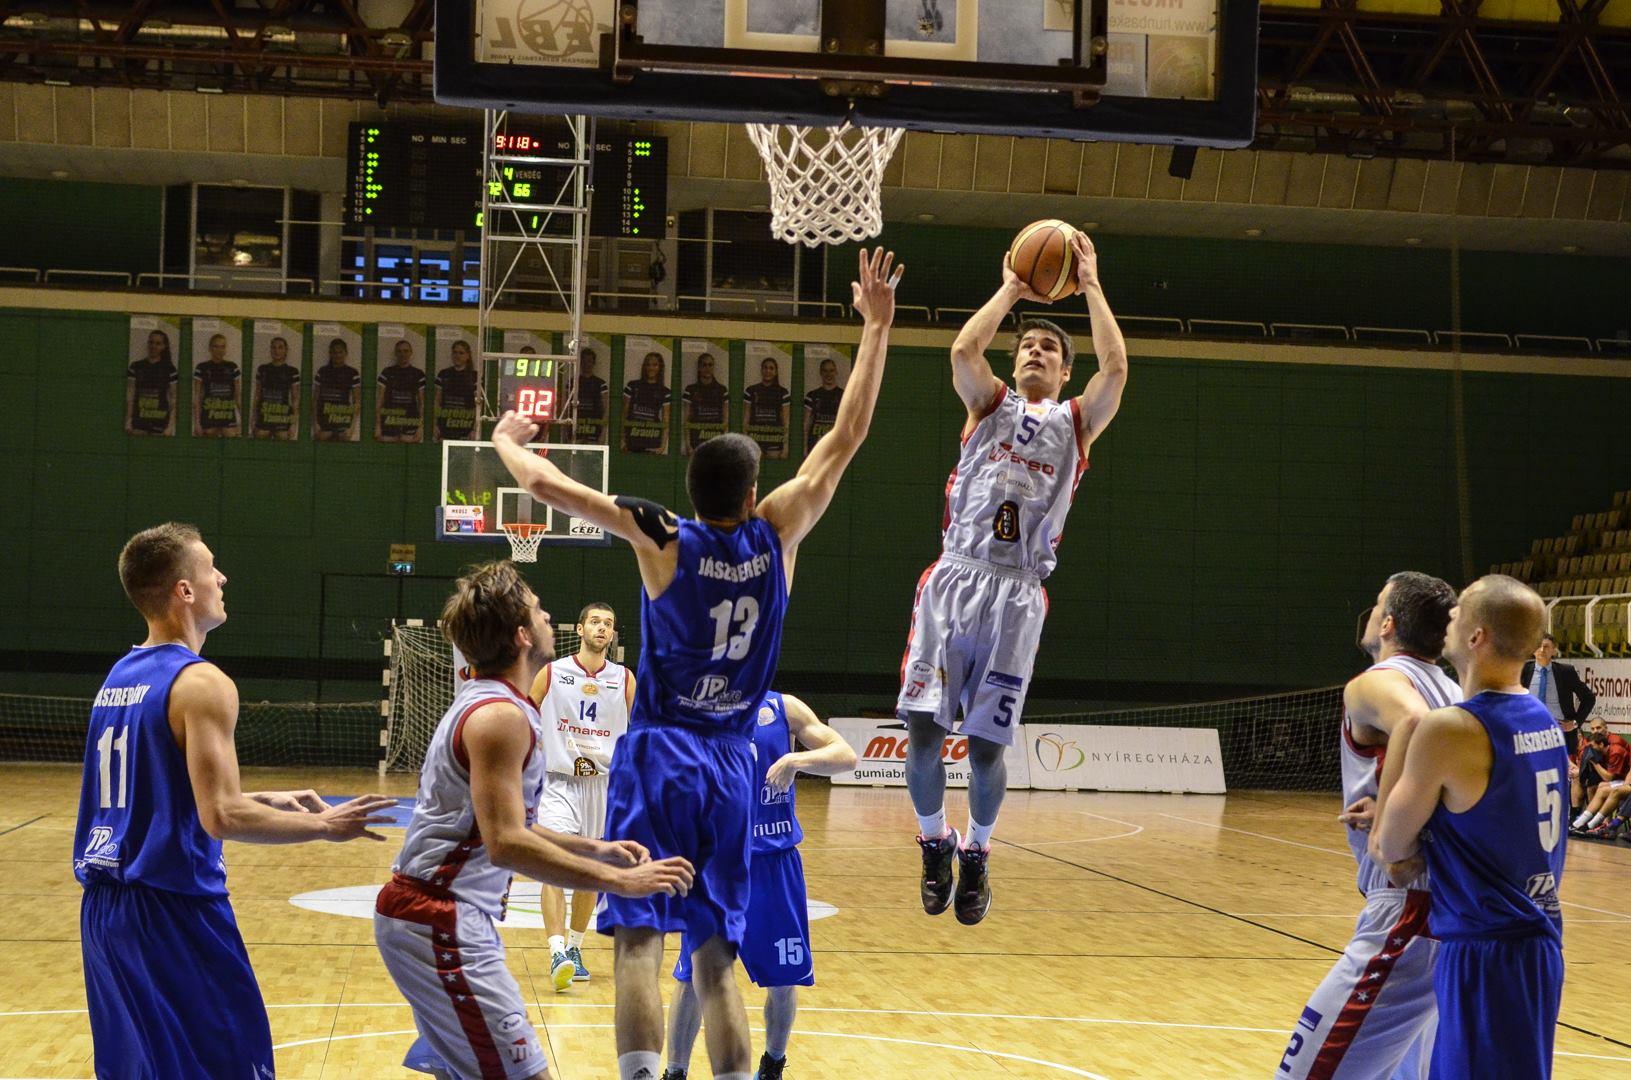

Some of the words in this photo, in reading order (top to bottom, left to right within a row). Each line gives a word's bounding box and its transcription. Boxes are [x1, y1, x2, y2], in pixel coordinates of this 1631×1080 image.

[412, 134, 424, 143] NO
[432, 136, 447, 144] MIN
[451, 136, 467, 145] SEC
[595, 143, 611, 151] SEC
[504, 167, 514, 181] 4
[513, 183, 531, 197] 66
[532, 215, 538, 229] 1
[518, 389, 553, 416] 02
[1016, 415, 1040, 446] 5
[571, 526, 601, 534] CEBL
[709, 596, 760, 661] 13
[579, 700, 597, 722] 14
[993, 694, 1017, 728] 5
[568, 722, 611, 737] marso
[863, 736, 969, 761] maso
[1091, 751, 1213, 765] NYÍREGYHÁZA
[97, 725, 129, 808] 11
[1536, 768, 1562, 853] 5
[753, 820, 792, 838] rium
[774, 937, 804, 965] 15
[1279, 1031, 1304, 1073] 2
